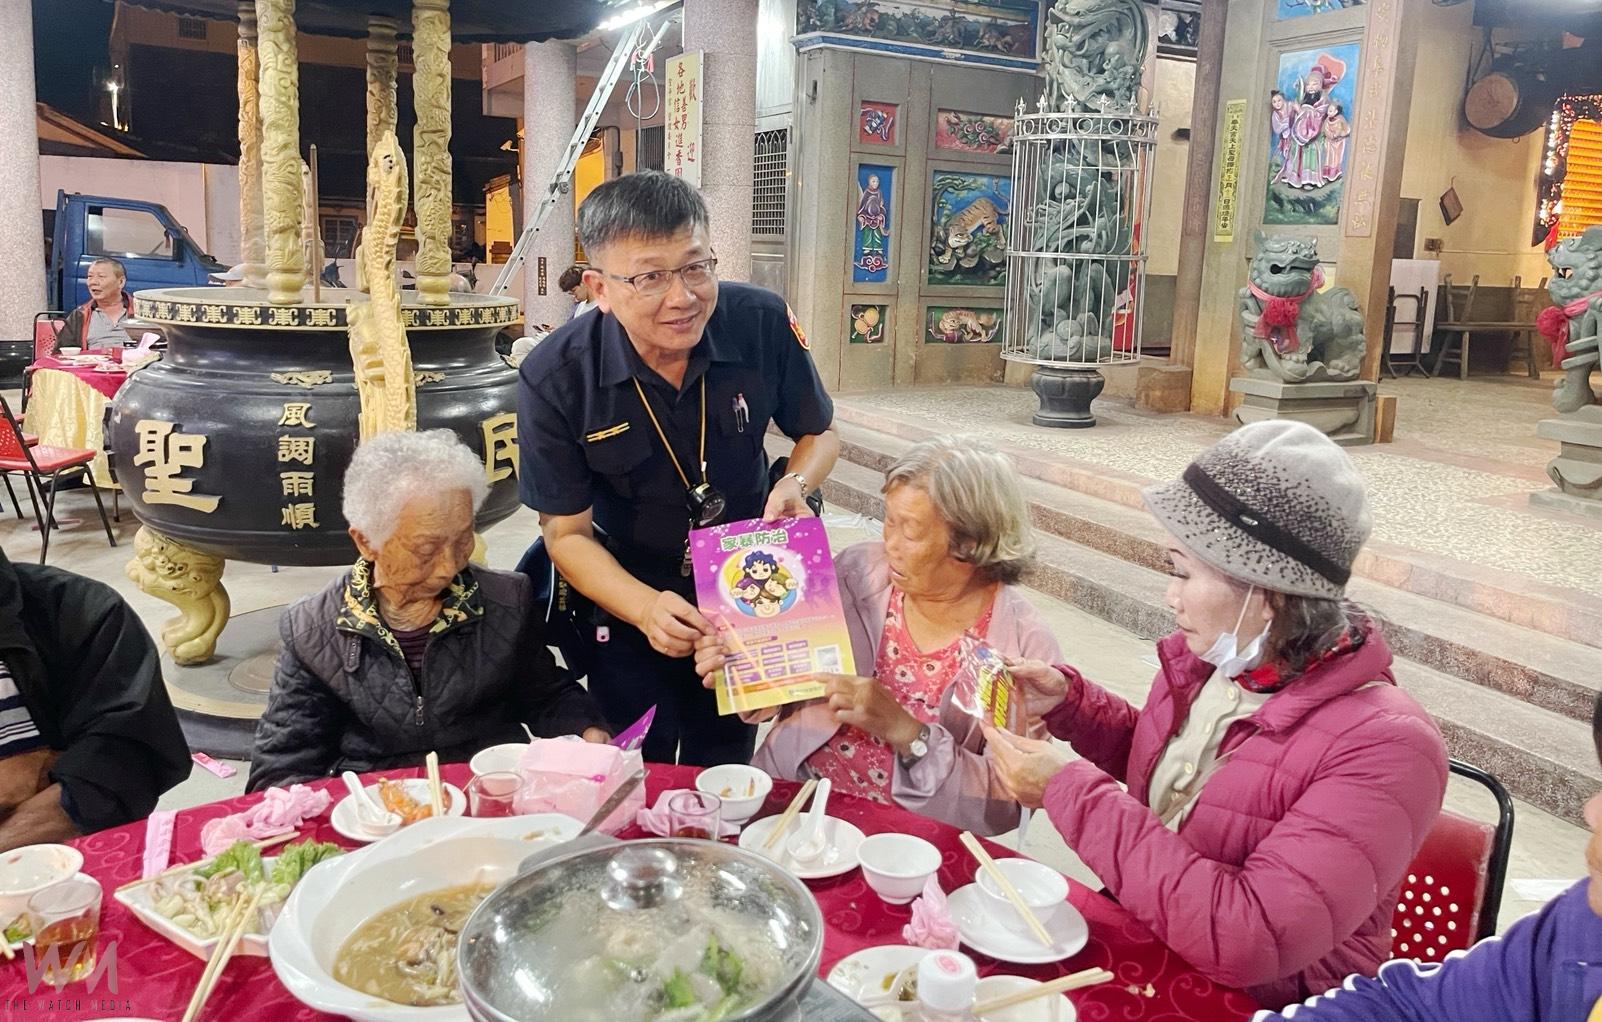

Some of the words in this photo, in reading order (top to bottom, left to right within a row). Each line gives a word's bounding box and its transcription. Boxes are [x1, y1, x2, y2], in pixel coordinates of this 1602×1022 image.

[134, 419, 223, 514] 聖
[277, 402, 321, 530] 風調雨順
[482, 411, 520, 483] 民
[721, 529, 789, 552] 家暴防治
